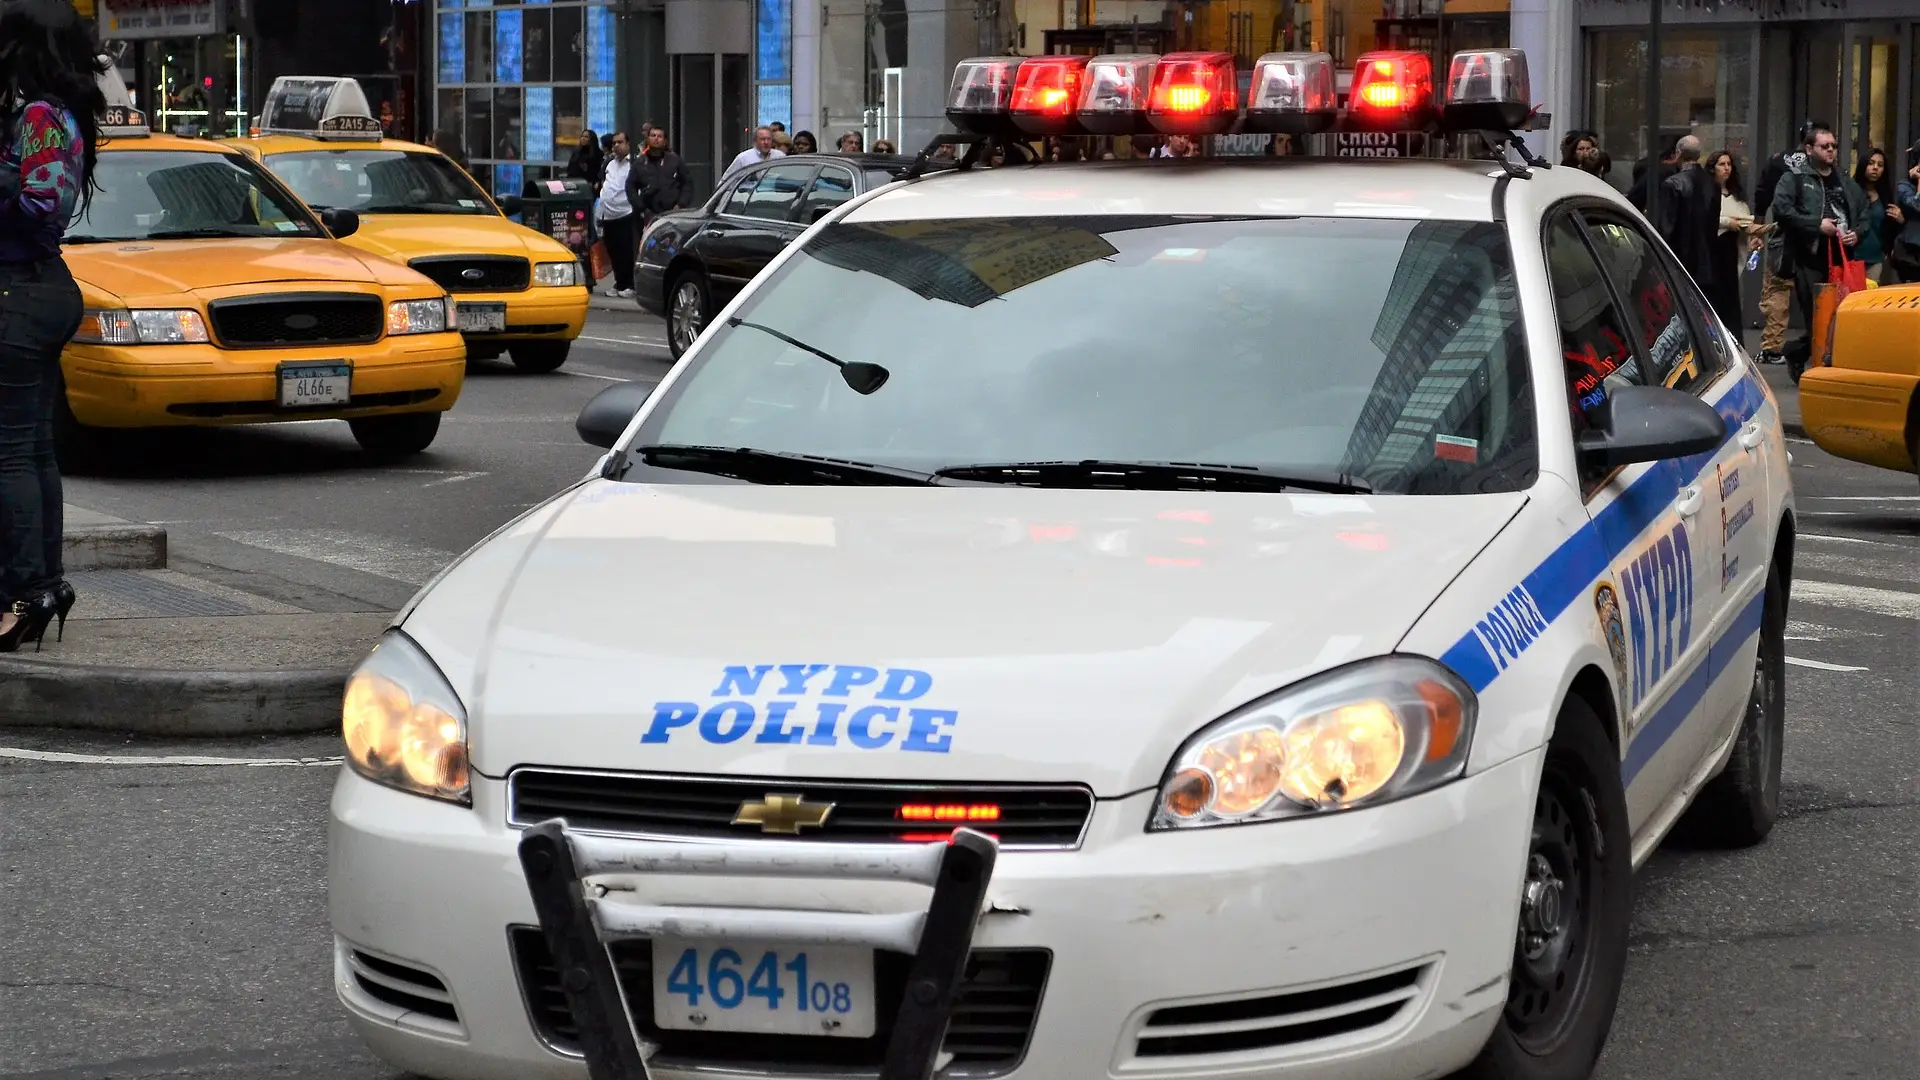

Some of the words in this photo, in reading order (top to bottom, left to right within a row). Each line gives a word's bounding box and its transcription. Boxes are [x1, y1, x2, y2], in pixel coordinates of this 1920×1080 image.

[340, 118, 362, 130] 2A15
[1476, 585, 1547, 671] POLICE
[1621, 522, 1693, 710] NYPD
[711, 663, 933, 702] NYPD
[640, 701, 959, 754] POLICE
